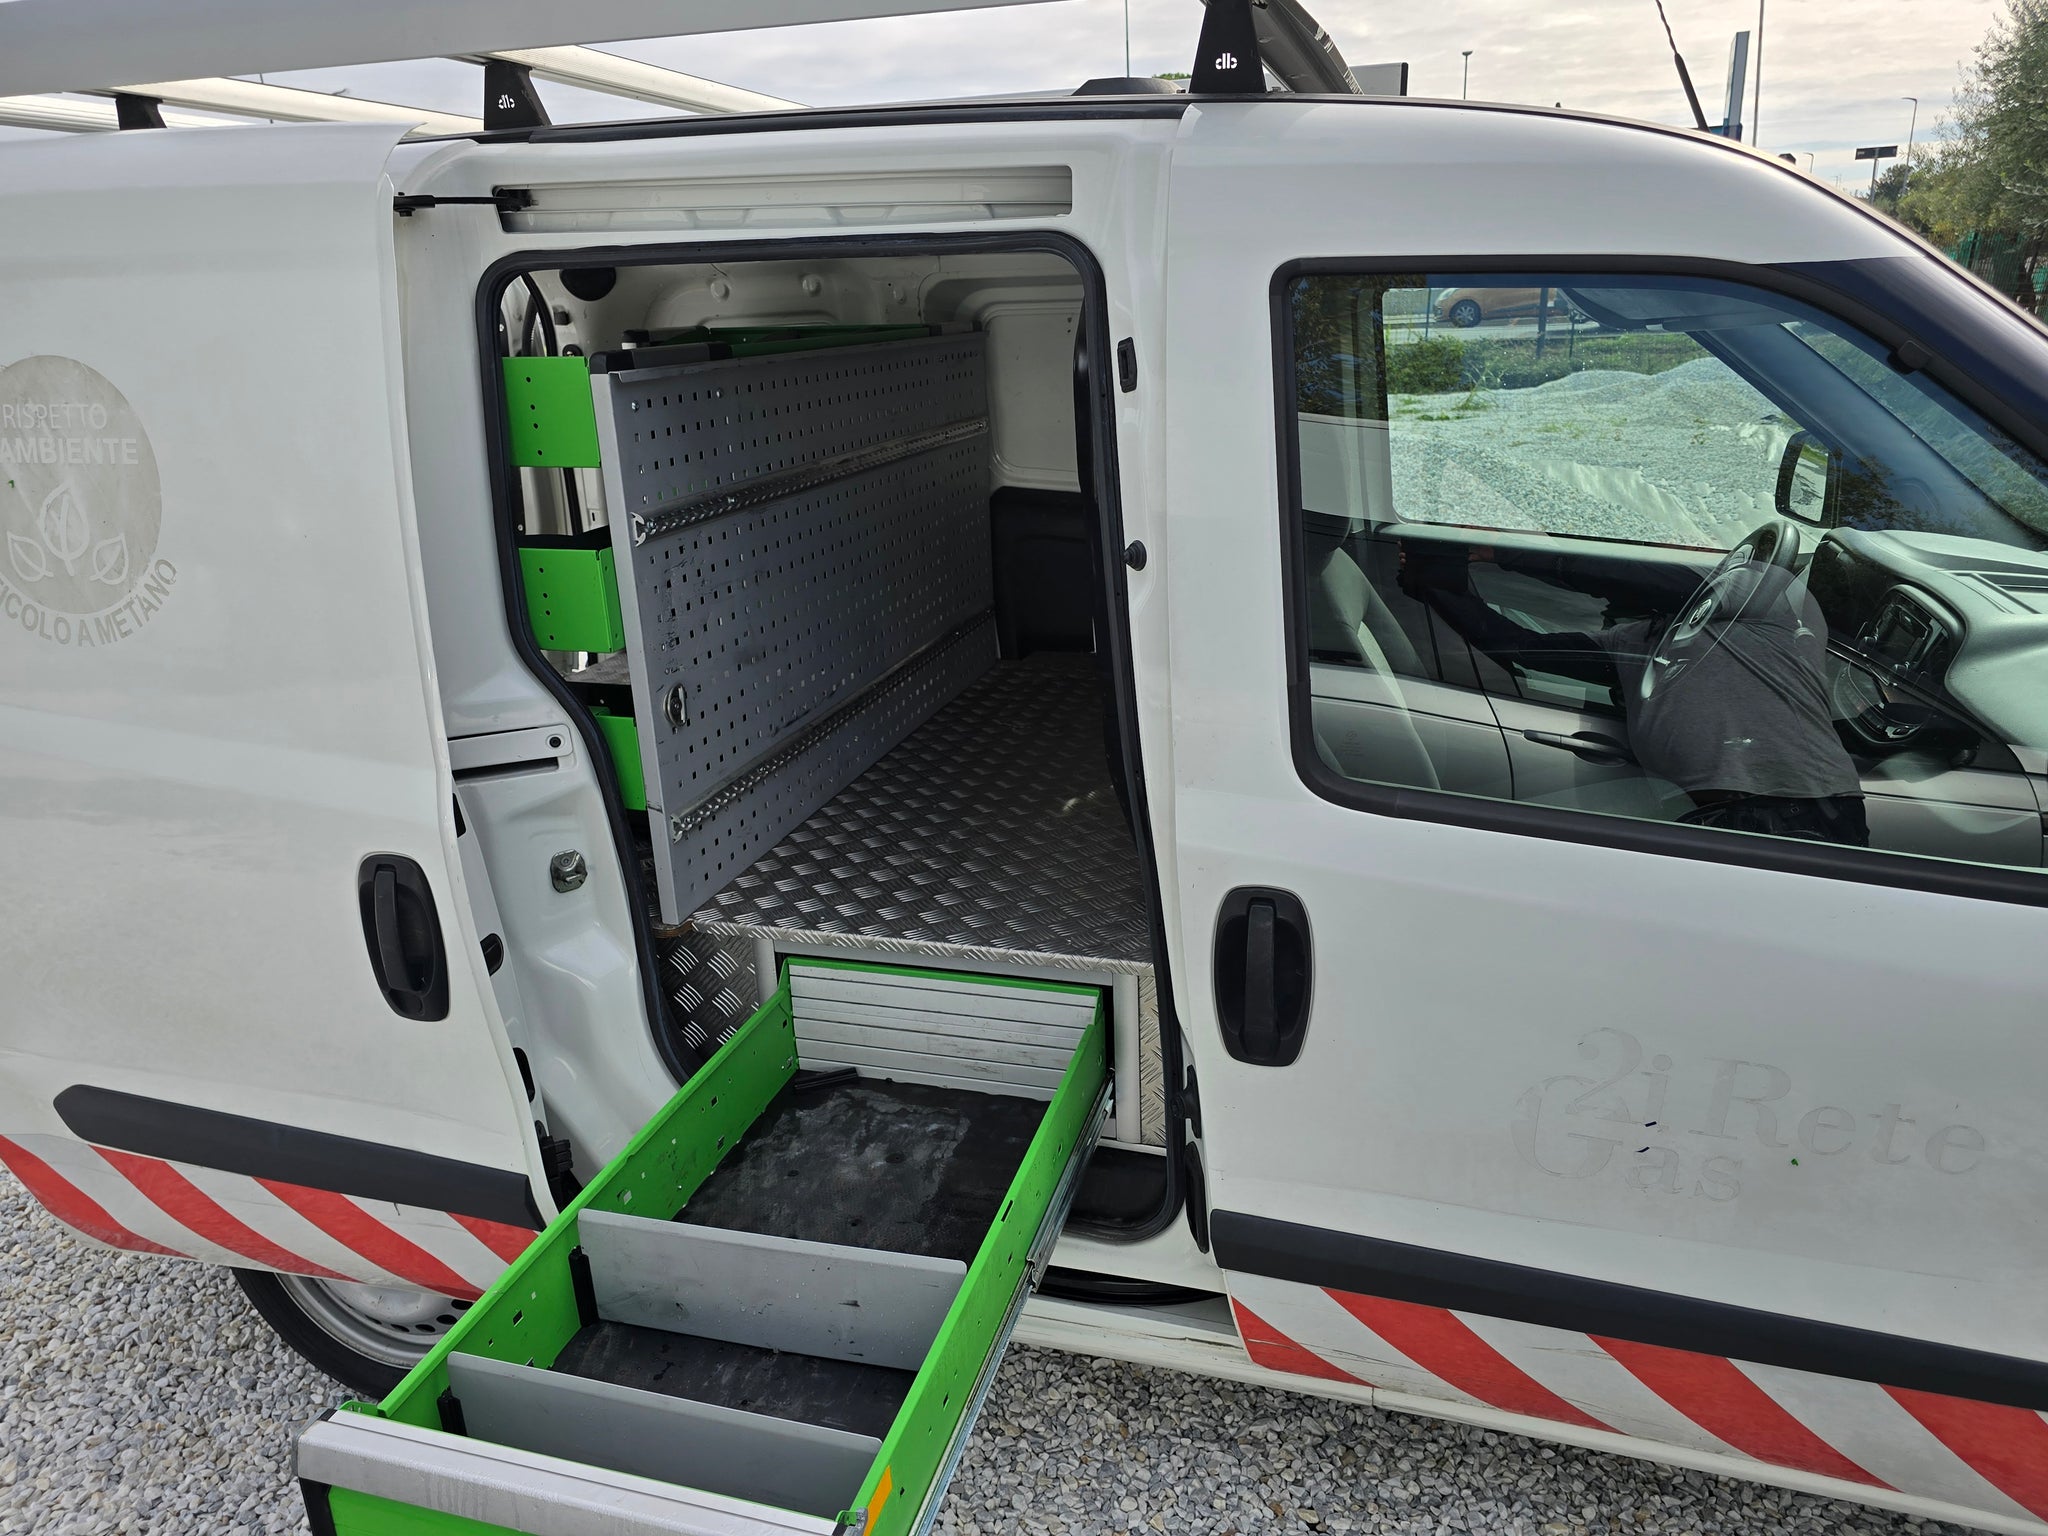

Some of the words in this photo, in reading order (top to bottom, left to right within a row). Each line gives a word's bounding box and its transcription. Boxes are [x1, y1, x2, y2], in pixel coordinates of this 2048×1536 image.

[3, 403, 108, 430] RISPETTO
[0, 579, 72, 646] ICOLO
[77, 618, 96, 648] A
[94, 558, 178, 646] METANO
[1510, 1074, 1746, 1202] Gas
[1688, 1055, 1987, 1175] Rete
